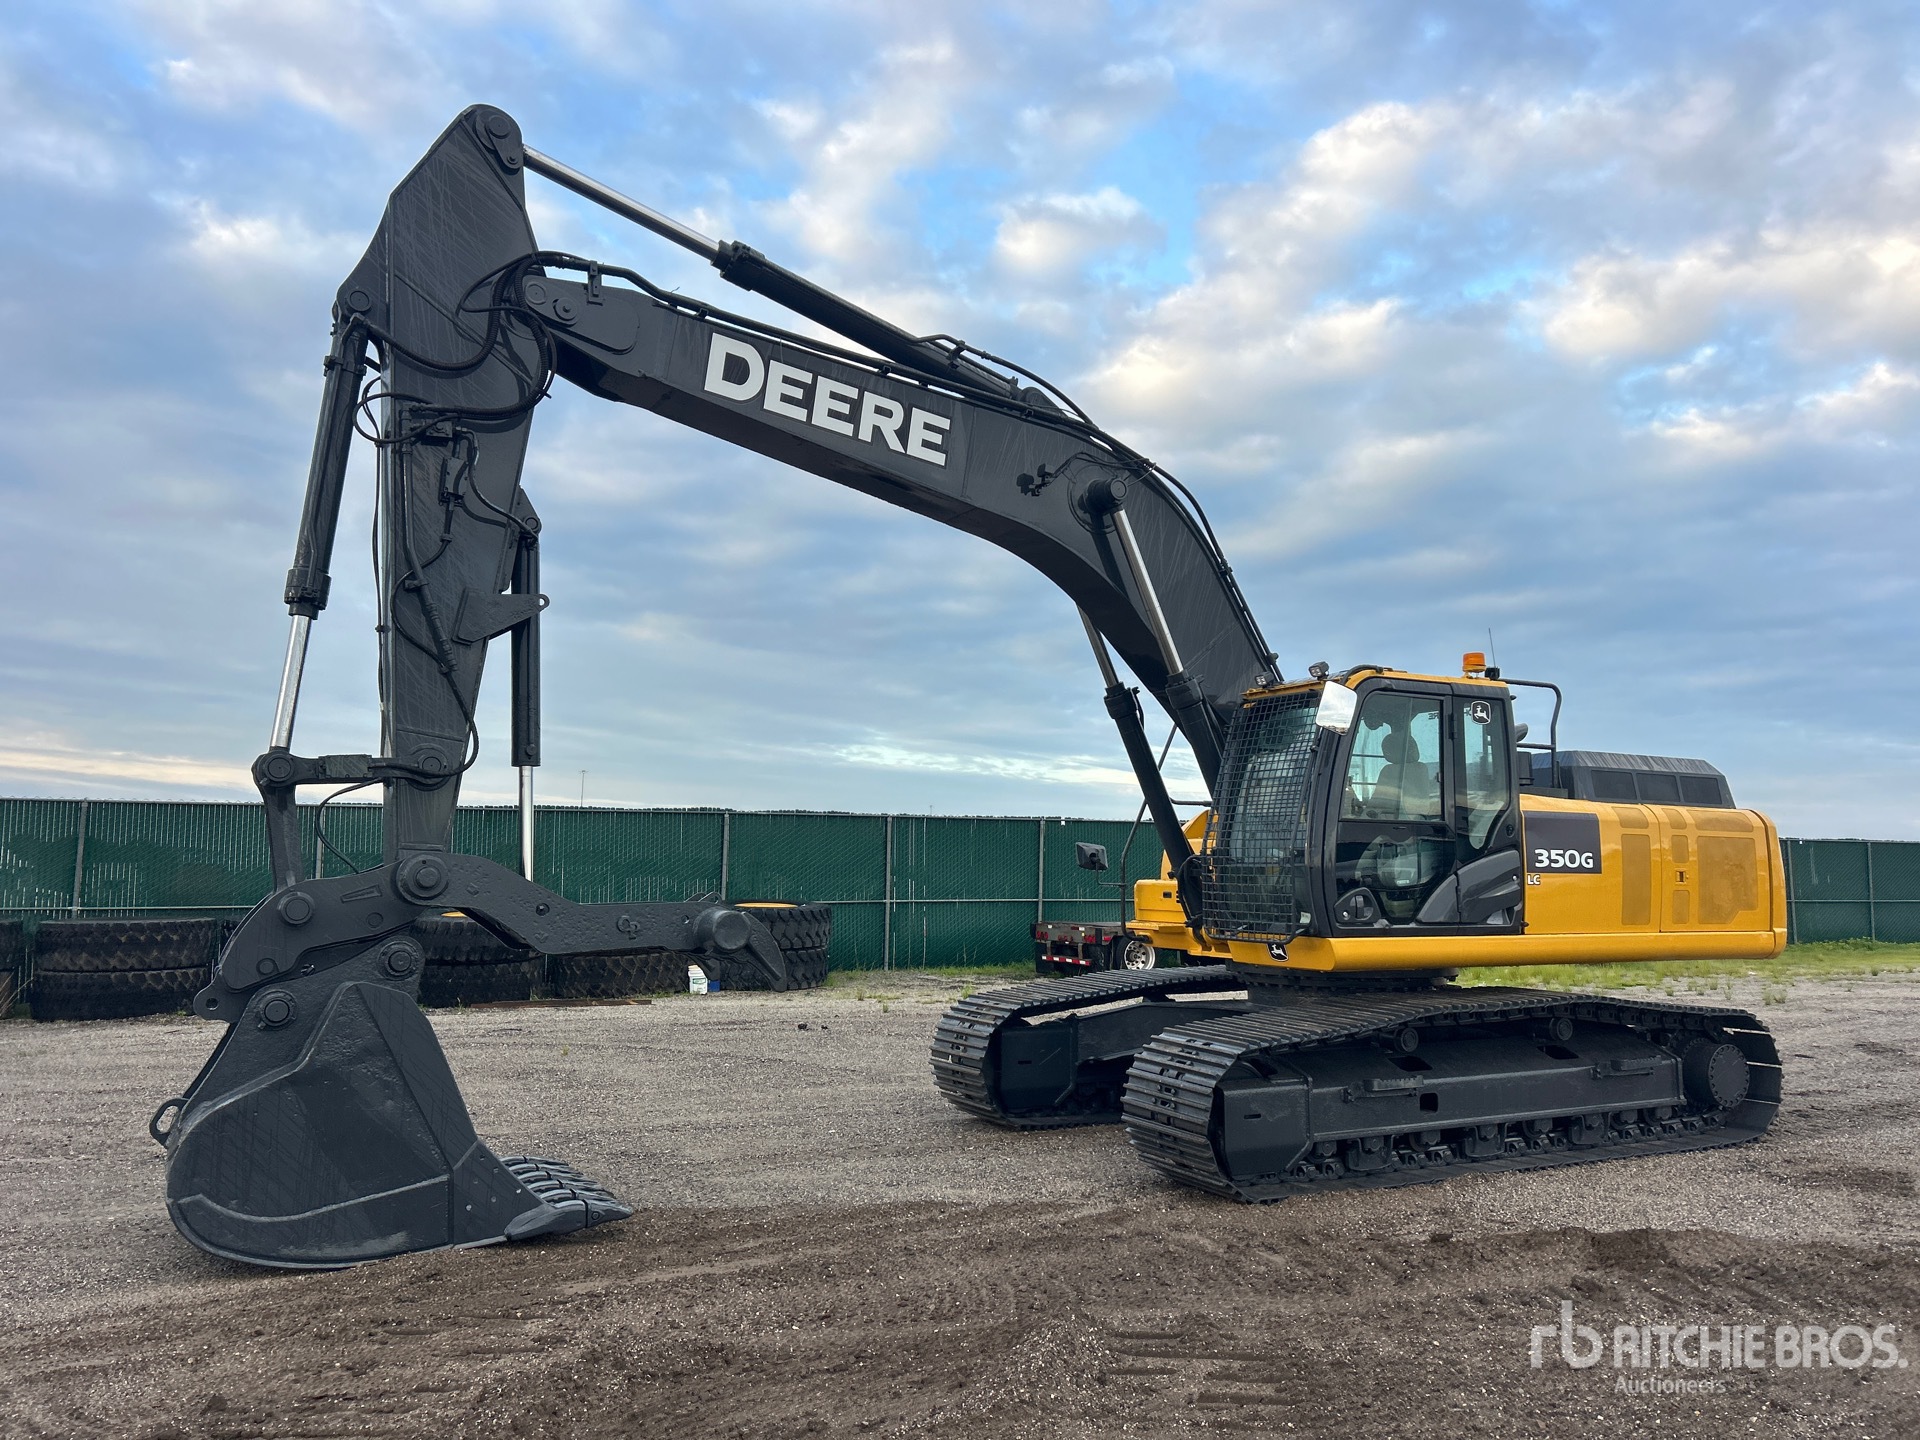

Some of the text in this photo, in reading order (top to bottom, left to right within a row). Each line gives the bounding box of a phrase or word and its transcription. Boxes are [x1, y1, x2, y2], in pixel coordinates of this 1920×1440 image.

[704, 332, 950, 466] DEERE
[1534, 848, 1594, 868] 350G
[1527, 875, 1540, 884] LC
